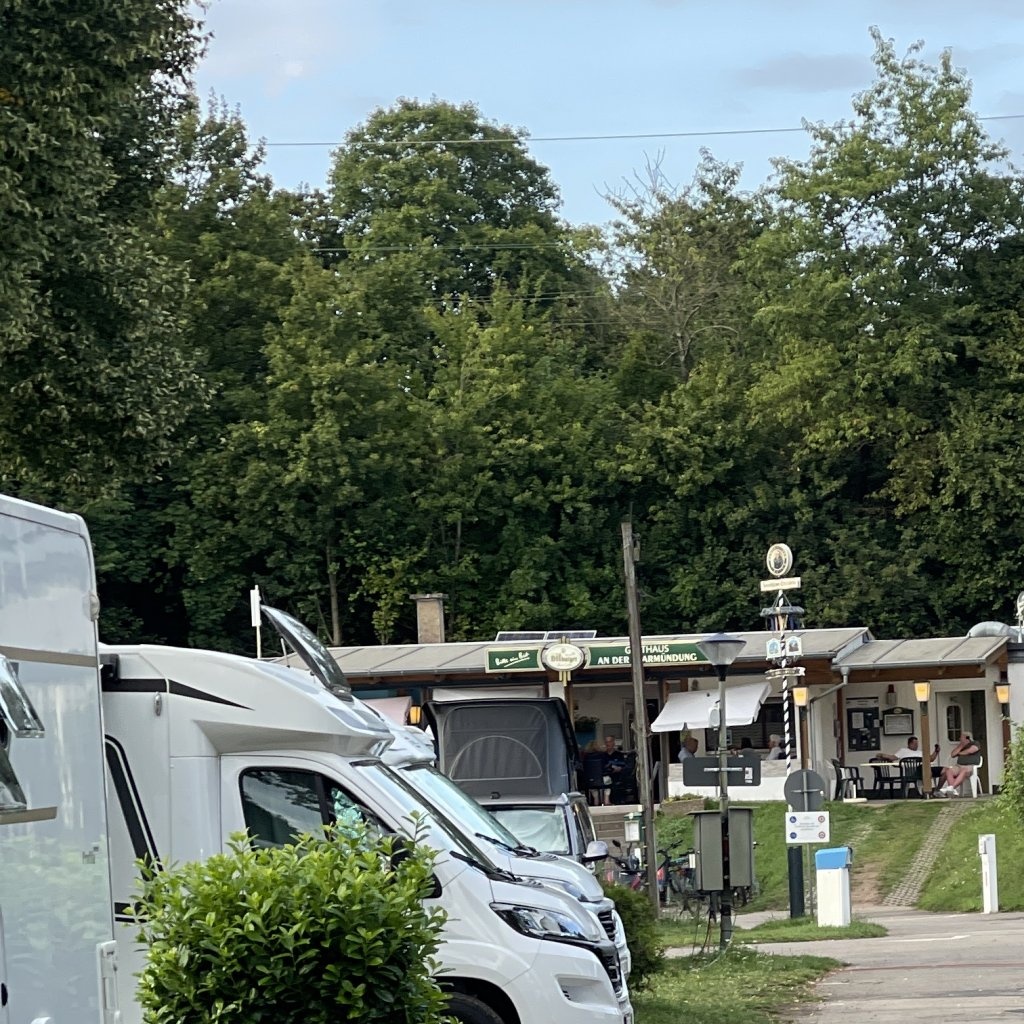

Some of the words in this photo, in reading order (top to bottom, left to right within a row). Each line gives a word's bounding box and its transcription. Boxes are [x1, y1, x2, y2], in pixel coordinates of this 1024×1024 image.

[624, 645, 670, 655] GTHAUS
[597, 656, 610, 665] AN
[612, 655, 629, 664] DER
